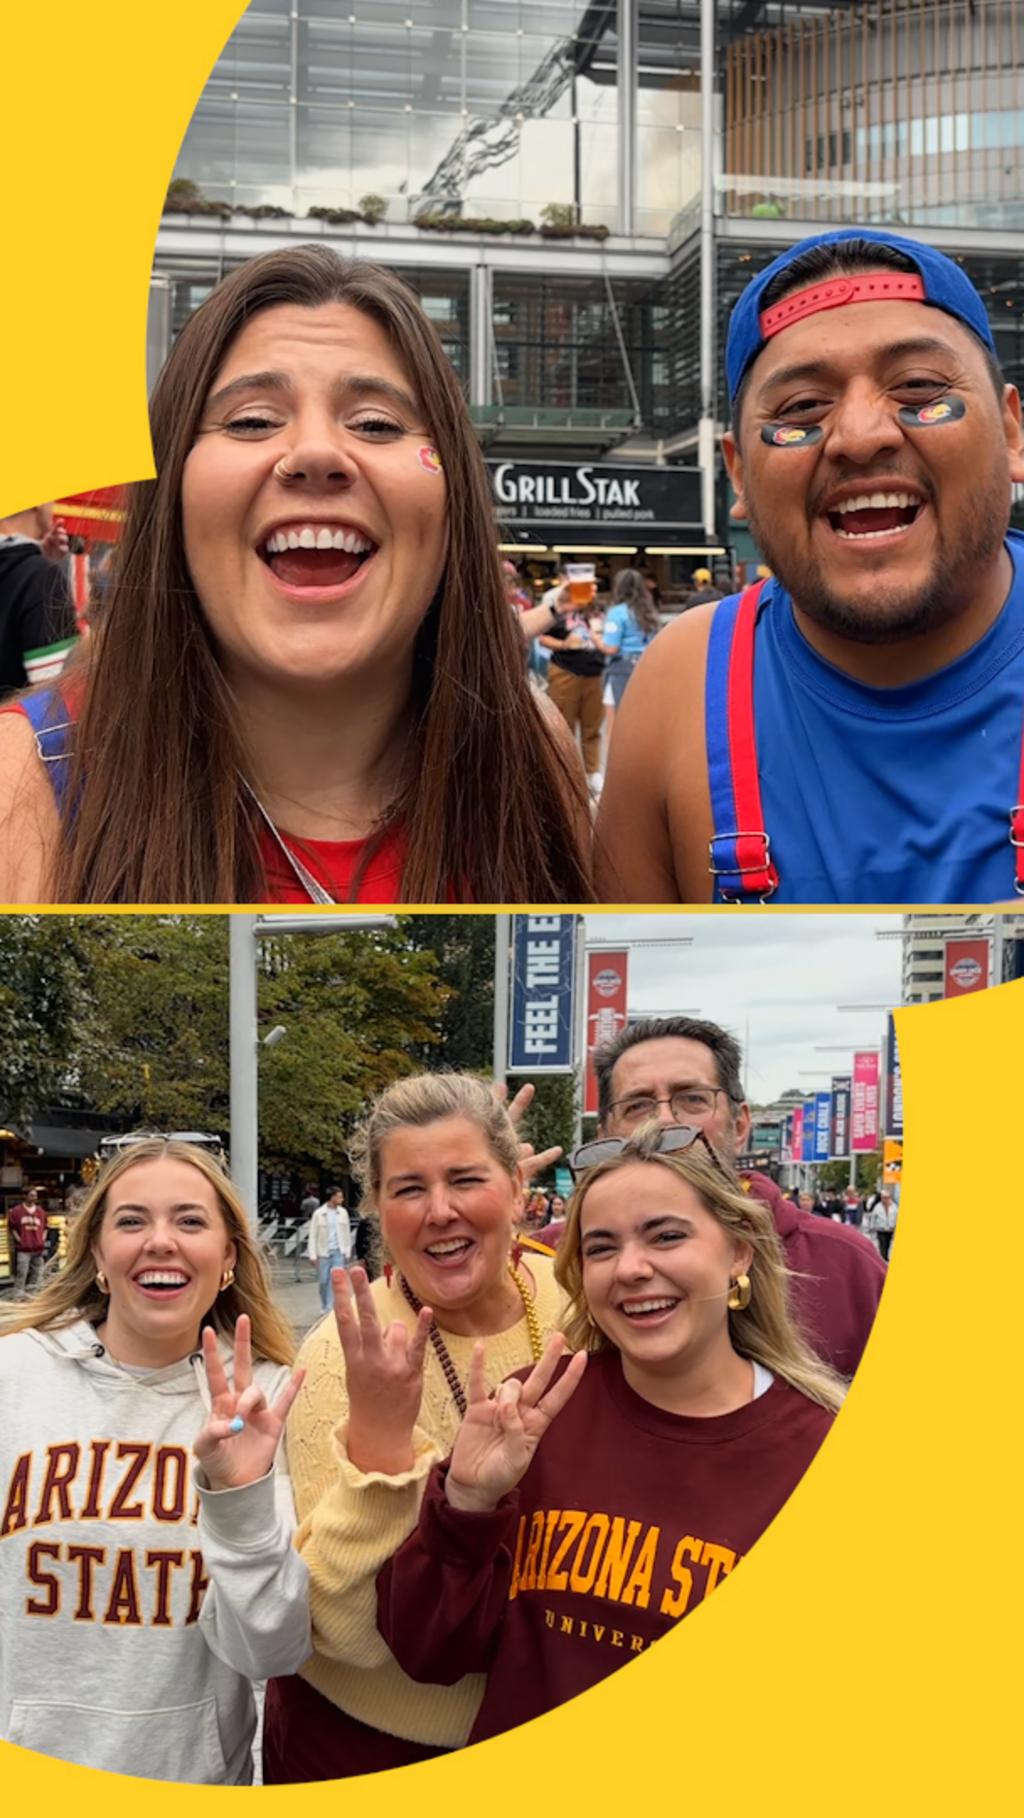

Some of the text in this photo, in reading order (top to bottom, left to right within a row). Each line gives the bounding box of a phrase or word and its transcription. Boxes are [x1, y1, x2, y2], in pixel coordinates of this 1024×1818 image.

[524, 914, 561, 1053] FEEL THE E
[0, 1438, 200, 1540] ARIZO
[660, 1534, 745, 1619] ST
[544, 1608, 657, 1652] UNIVER
